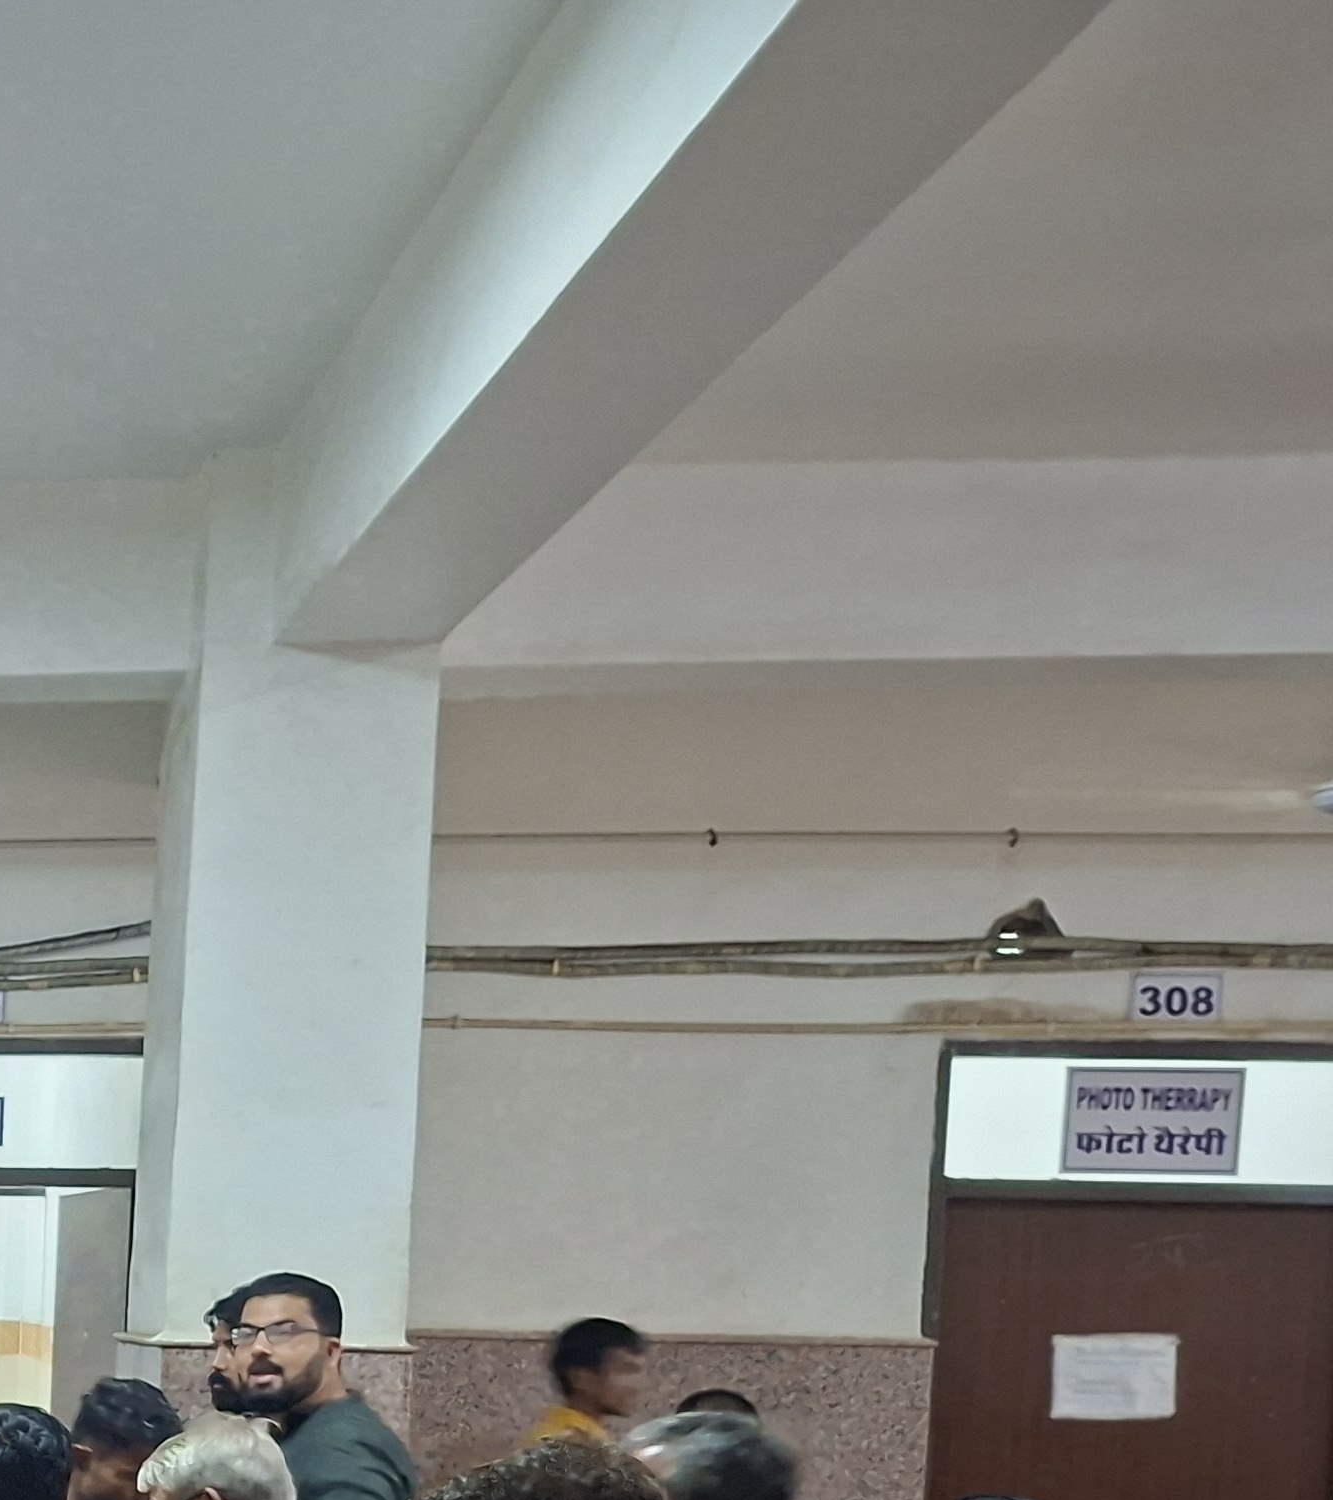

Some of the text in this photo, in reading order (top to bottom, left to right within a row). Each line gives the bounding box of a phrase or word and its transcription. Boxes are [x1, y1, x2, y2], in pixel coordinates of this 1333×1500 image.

[1139, 986, 1215, 1016] 308
[1076, 1087, 1135, 1110] PHOTO
[1076, 1125, 1147, 1154] फोटो
